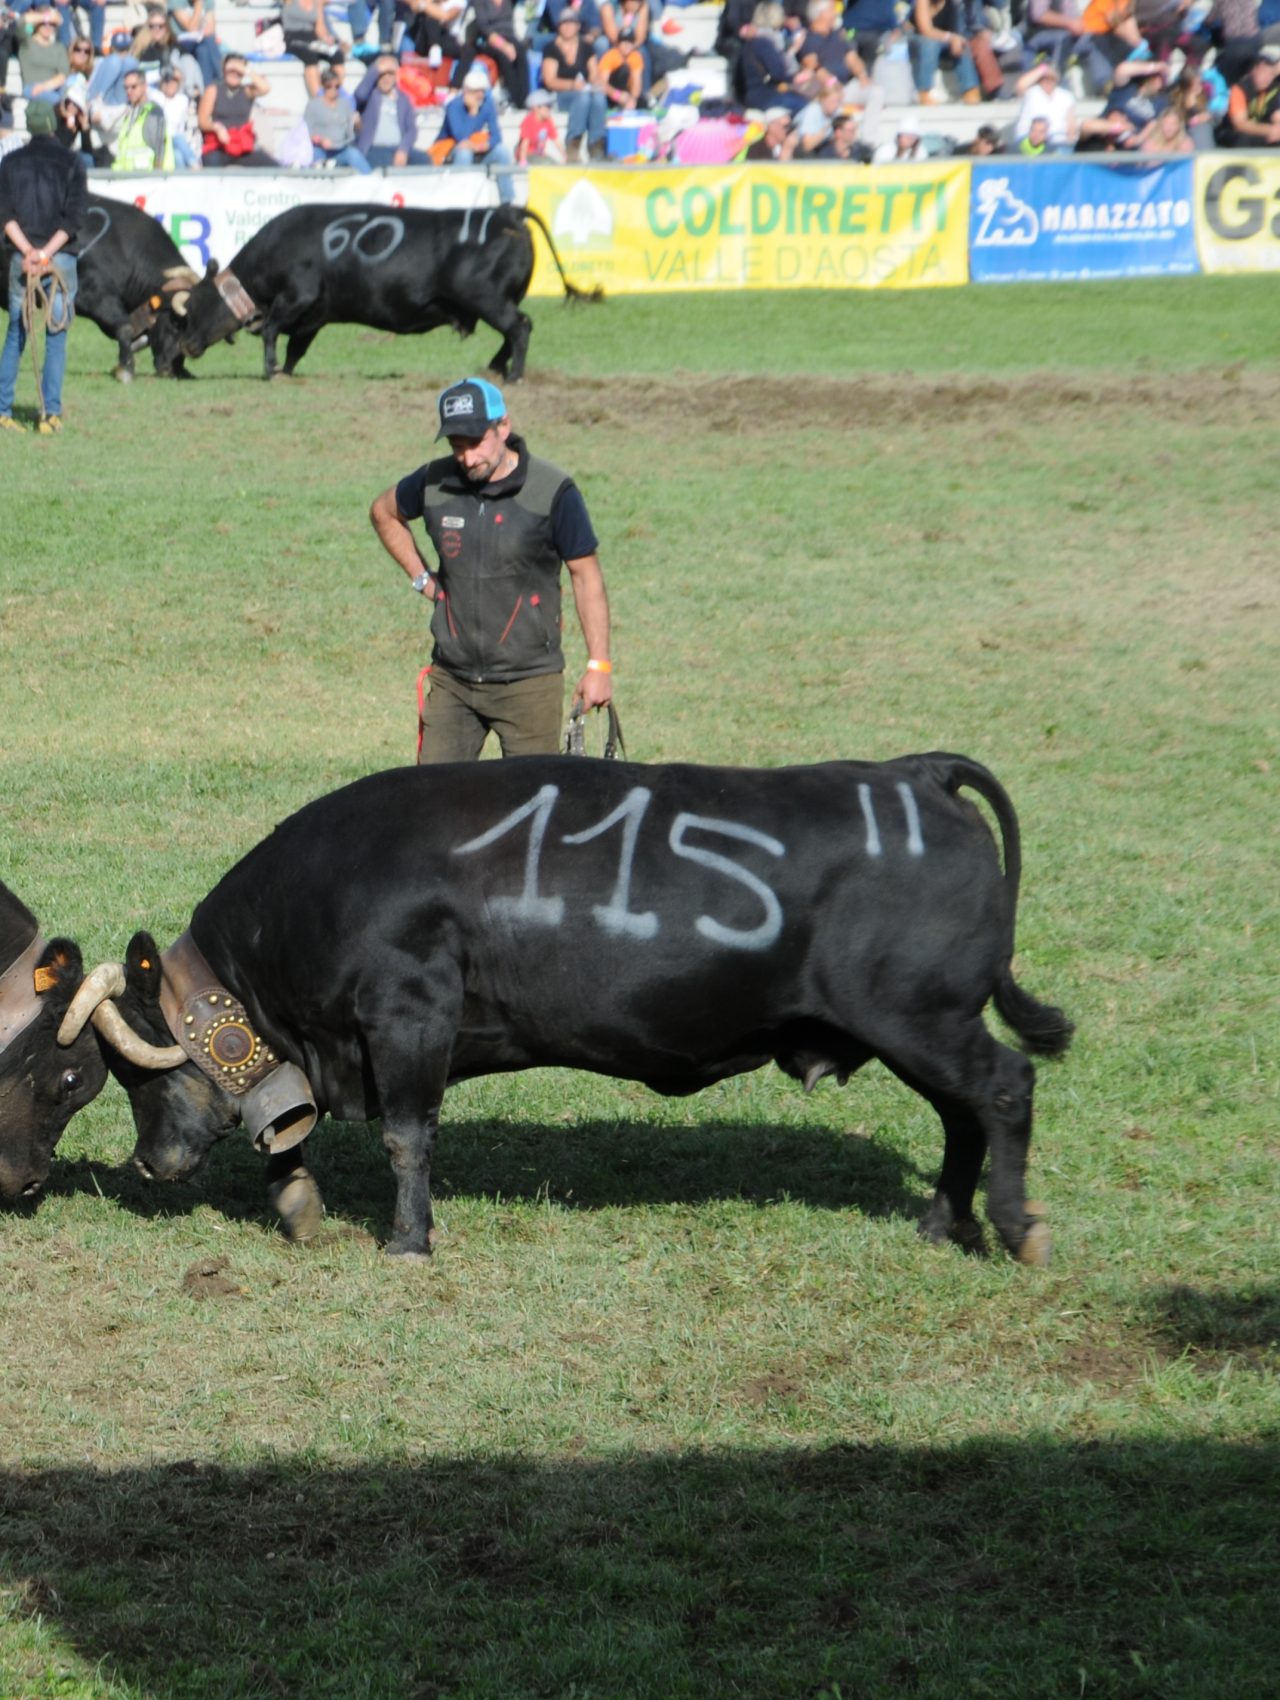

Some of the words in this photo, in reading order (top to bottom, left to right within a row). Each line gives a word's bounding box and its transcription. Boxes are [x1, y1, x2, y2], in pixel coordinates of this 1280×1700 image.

[646, 178, 950, 238] COLDIRETTI
[1041, 199, 1190, 231] MARAZZATO
[1204, 163, 1280, 241] G
[323, 212, 405, 266] 60
[644, 248, 765, 282] VALLE
[775, 244, 946, 282] D'AOSTA
[452, 784, 787, 952] 115
